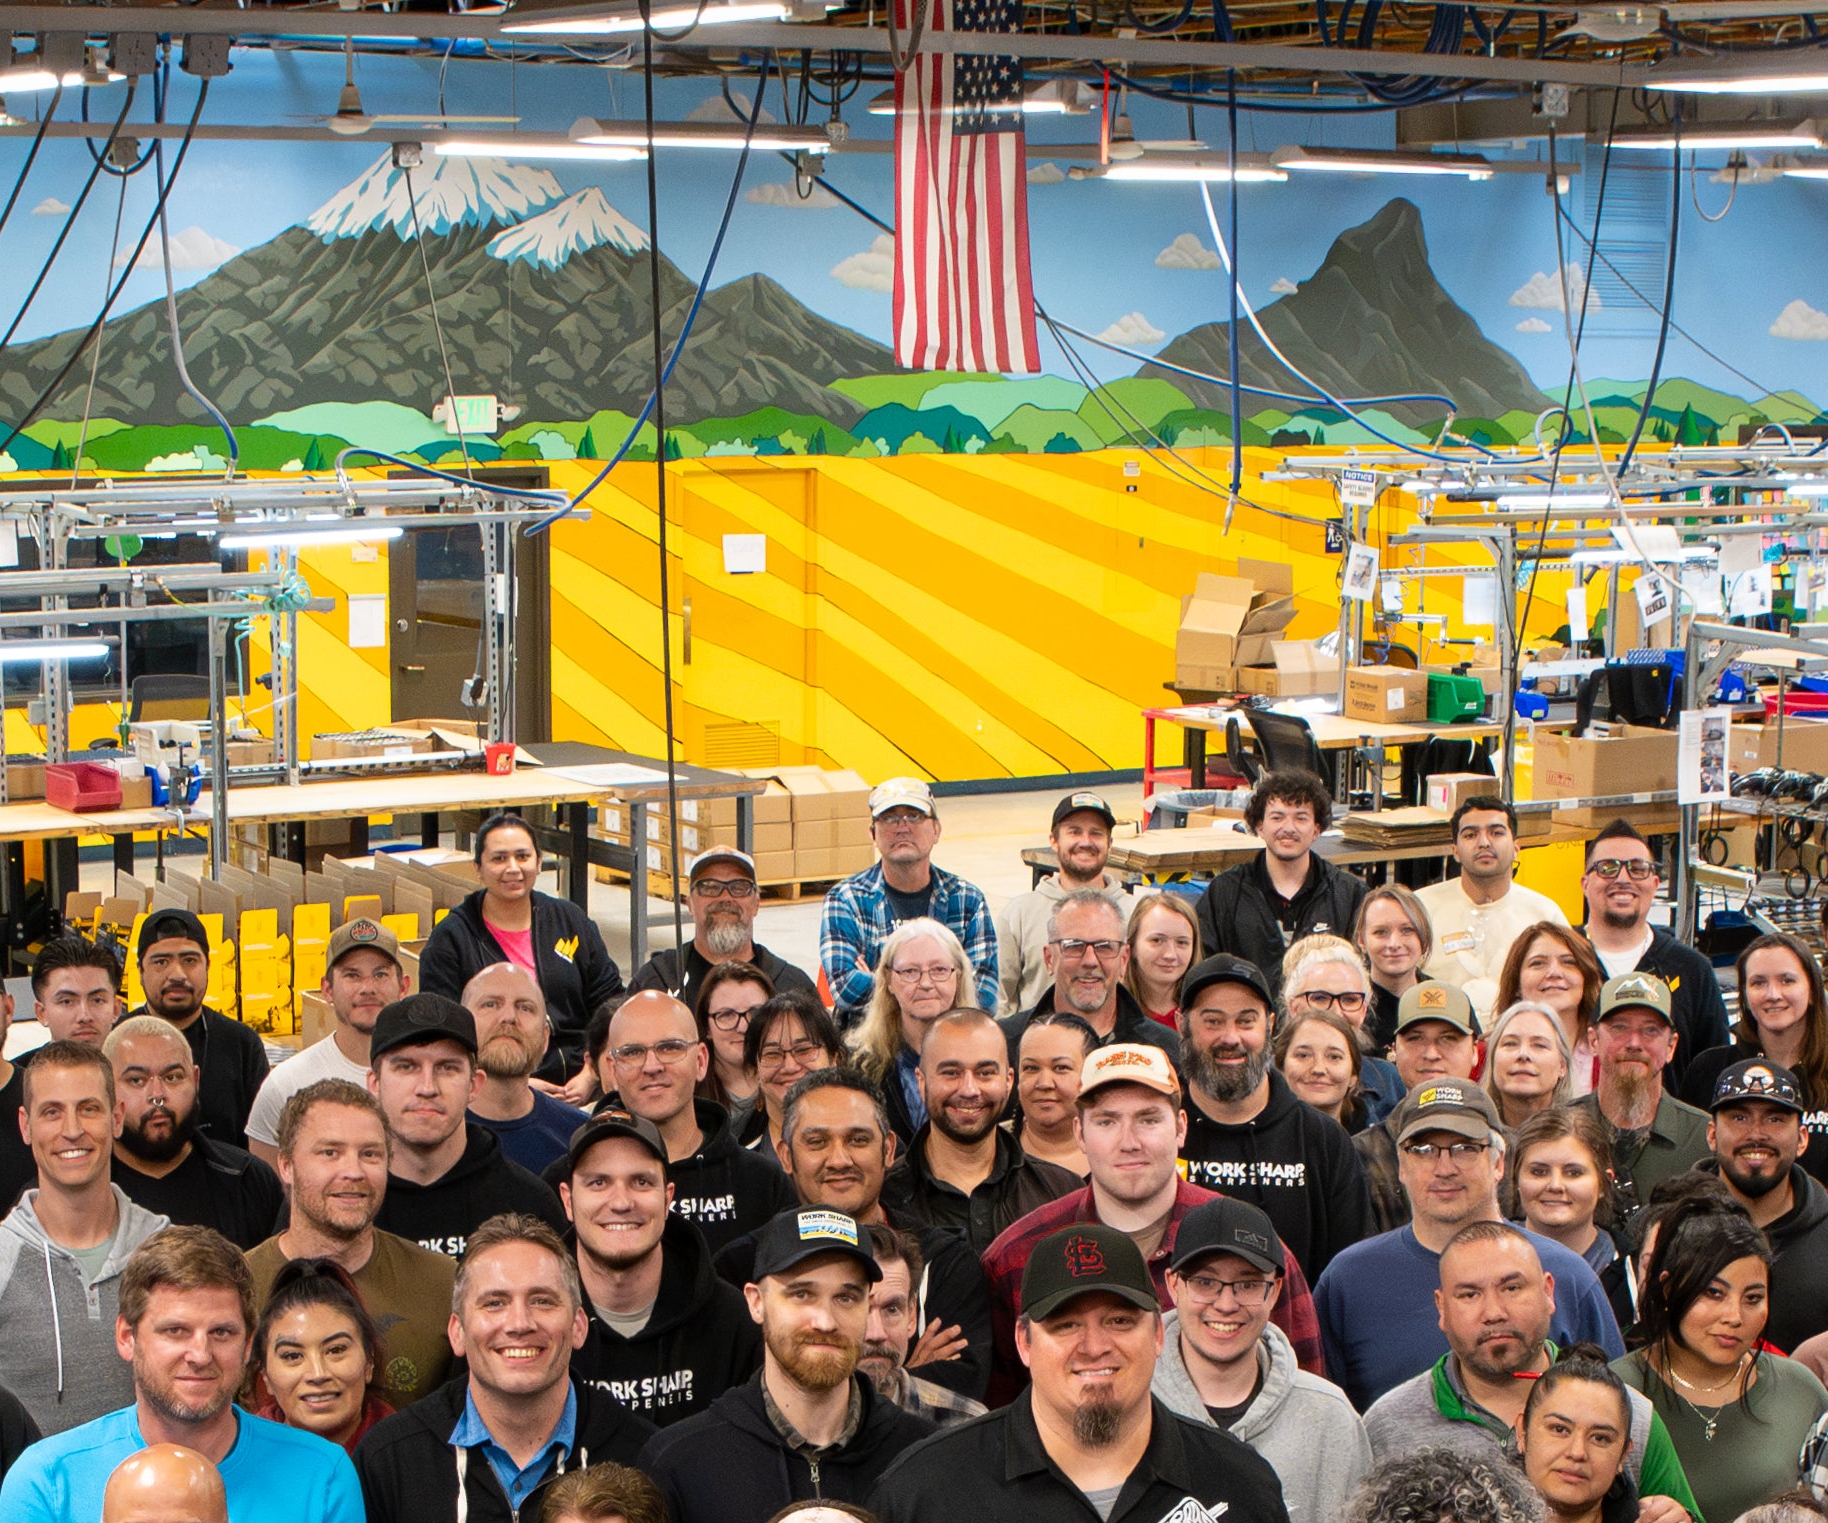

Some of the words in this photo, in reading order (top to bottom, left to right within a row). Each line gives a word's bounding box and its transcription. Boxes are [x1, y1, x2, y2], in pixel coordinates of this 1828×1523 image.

[457, 398, 490, 427] EXIT
[1345, 470, 1373, 482] NOTICE
[1436, 1087, 1462, 1096] WORK
[1189, 1161, 1246, 1178] WORK
[1250, 1161, 1305, 1179] SHARP
[801, 1213, 826, 1221] WORK
[828, 1213, 853, 1224] SHARP
[632, 1391, 693, 1411] PENES
